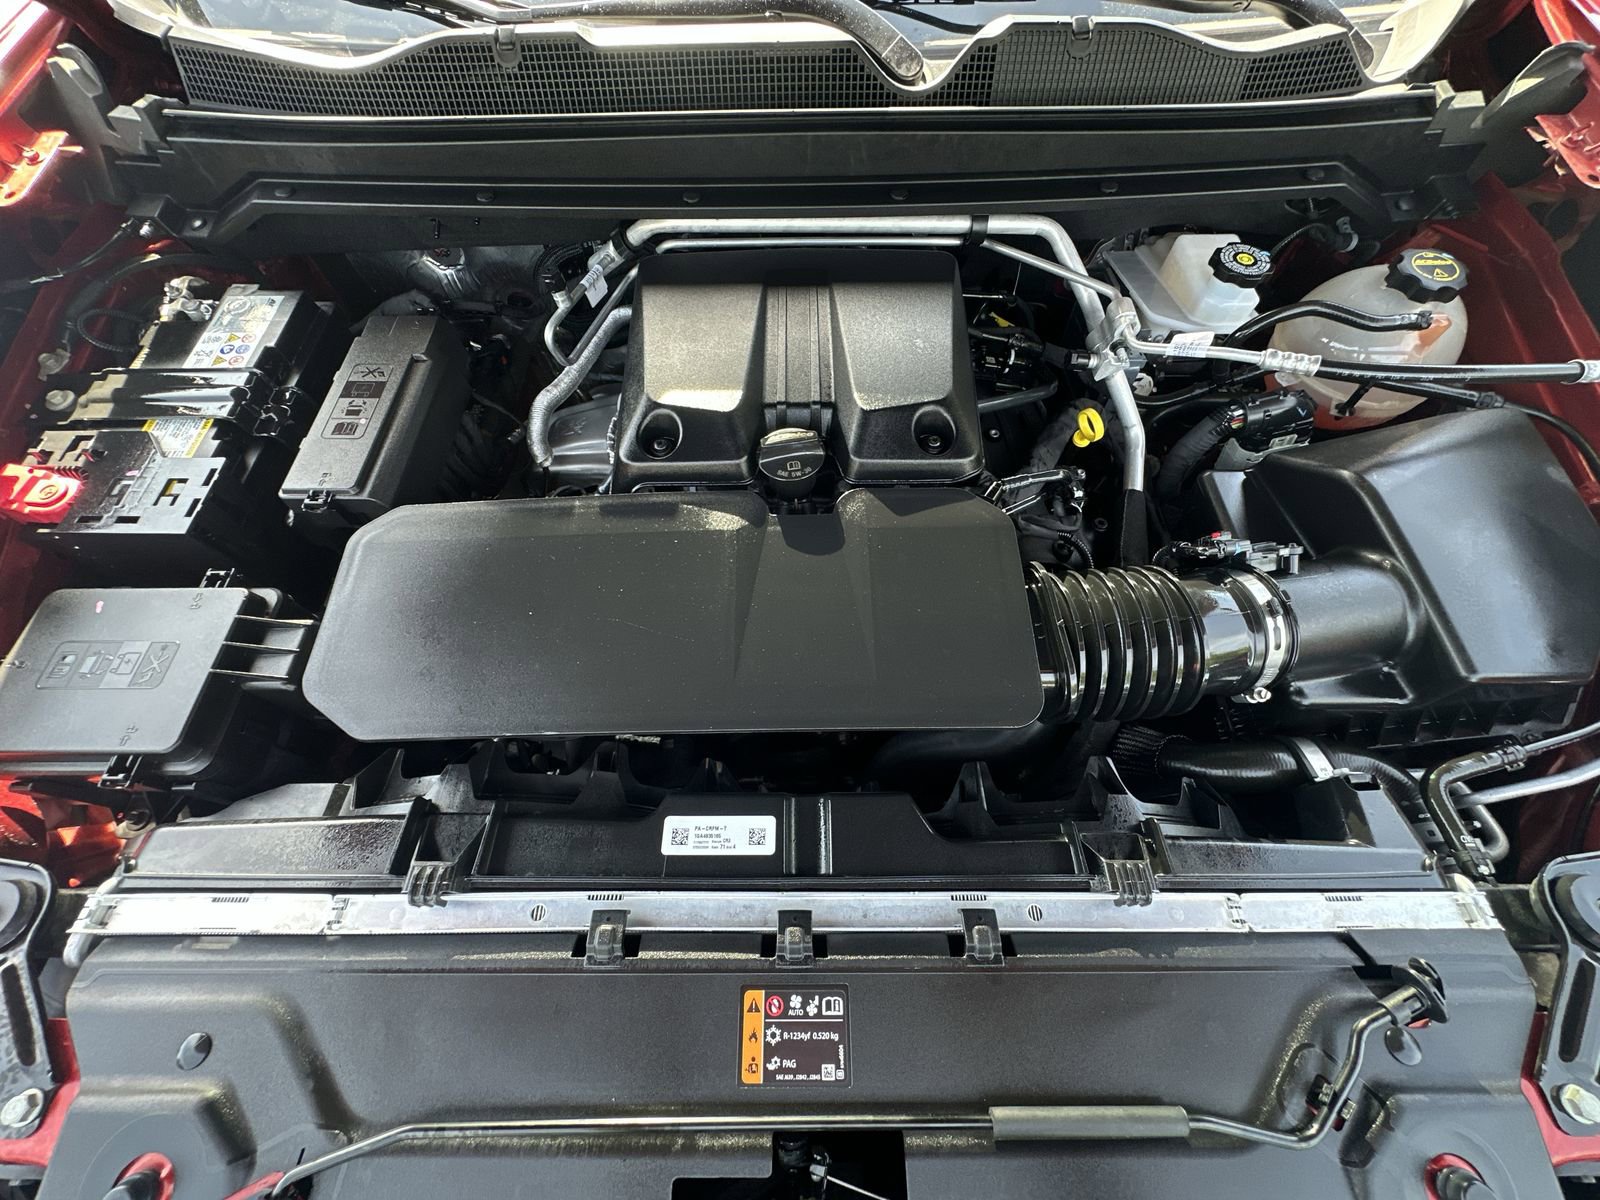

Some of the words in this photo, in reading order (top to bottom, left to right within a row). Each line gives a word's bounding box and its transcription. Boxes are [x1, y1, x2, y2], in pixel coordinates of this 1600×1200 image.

[783, 1031, 811, 1042] R-1234yf
[812, 1032, 829, 1040] 0.520
[830, 1031, 839, 1042] kg
[782, 1059, 797, 1068] PAG
